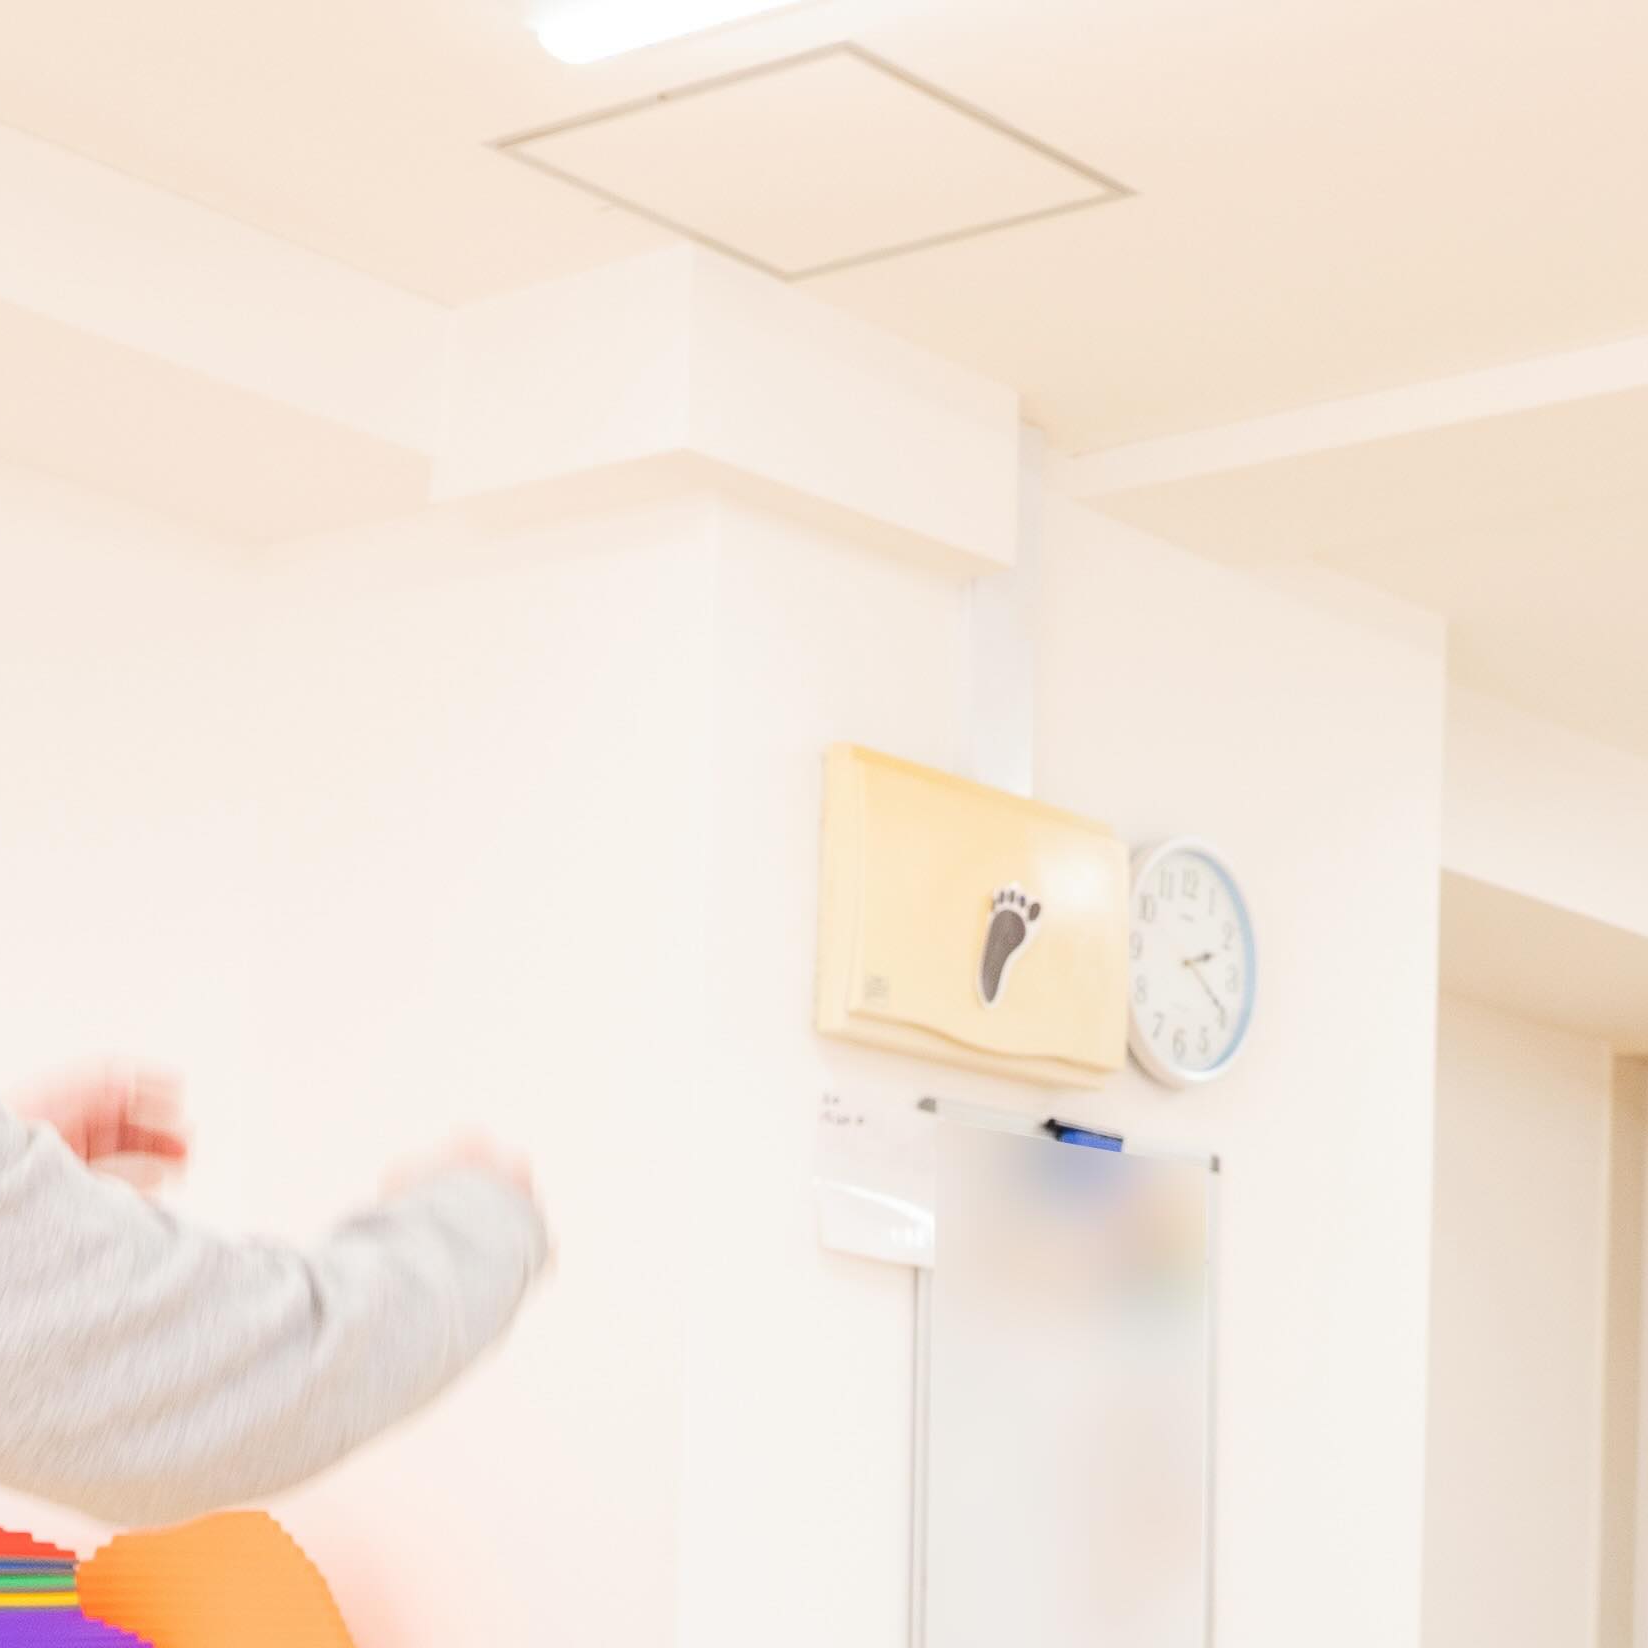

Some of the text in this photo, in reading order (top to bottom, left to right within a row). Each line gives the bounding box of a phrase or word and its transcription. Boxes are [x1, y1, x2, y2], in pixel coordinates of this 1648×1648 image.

[1130, 932, 1143, 960] 9
[1221, 922, 1235, 950] 2
[1152, 1012, 1165, 1039] 7
[1172, 1028, 1187, 1059] 6
